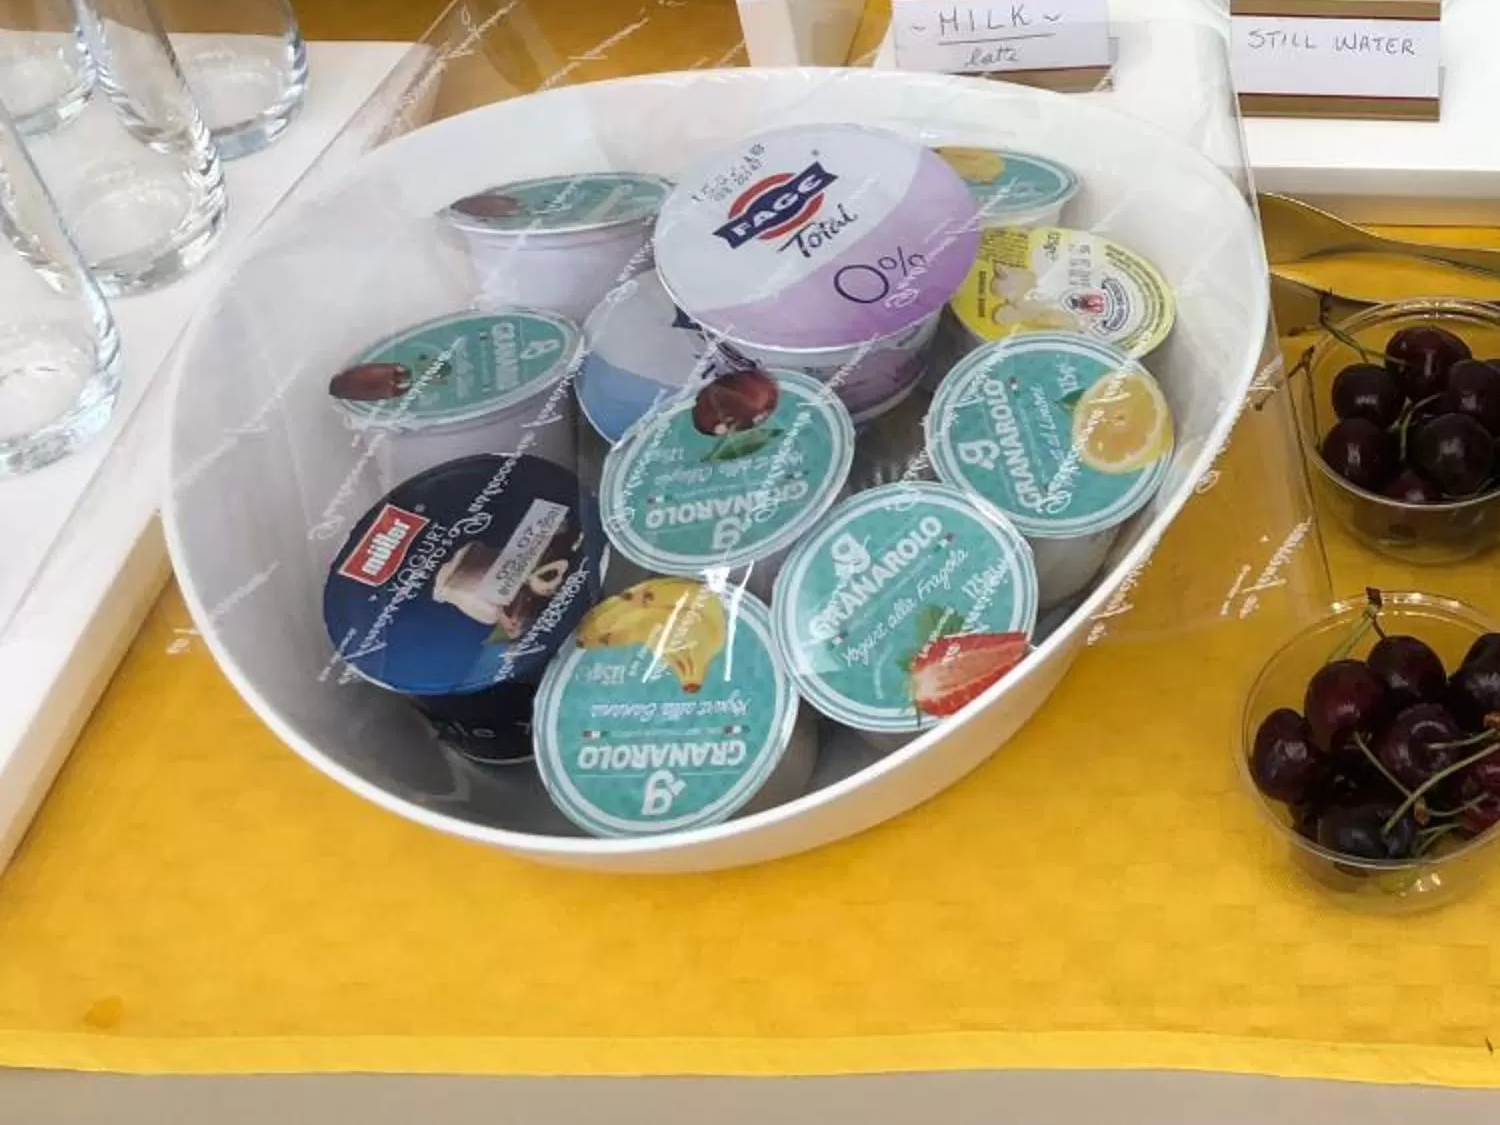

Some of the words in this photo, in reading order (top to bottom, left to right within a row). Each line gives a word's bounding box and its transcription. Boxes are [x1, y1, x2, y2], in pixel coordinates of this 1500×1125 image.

[937, 4, 1030, 37] MILK
[1247, 29, 1318, 52] STILL
[1334, 31, 1417, 57] WATER
[733, 173, 824, 238] FAGE
[776, 203, 859, 259] Total
[833, 246, 927, 304] 0%
[982, 379, 1042, 513] GRANAROLO
[361, 519, 411, 577] müller
[808, 515, 944, 641] GRANAROLO
[576, 740, 748, 770] GRANAROLO
